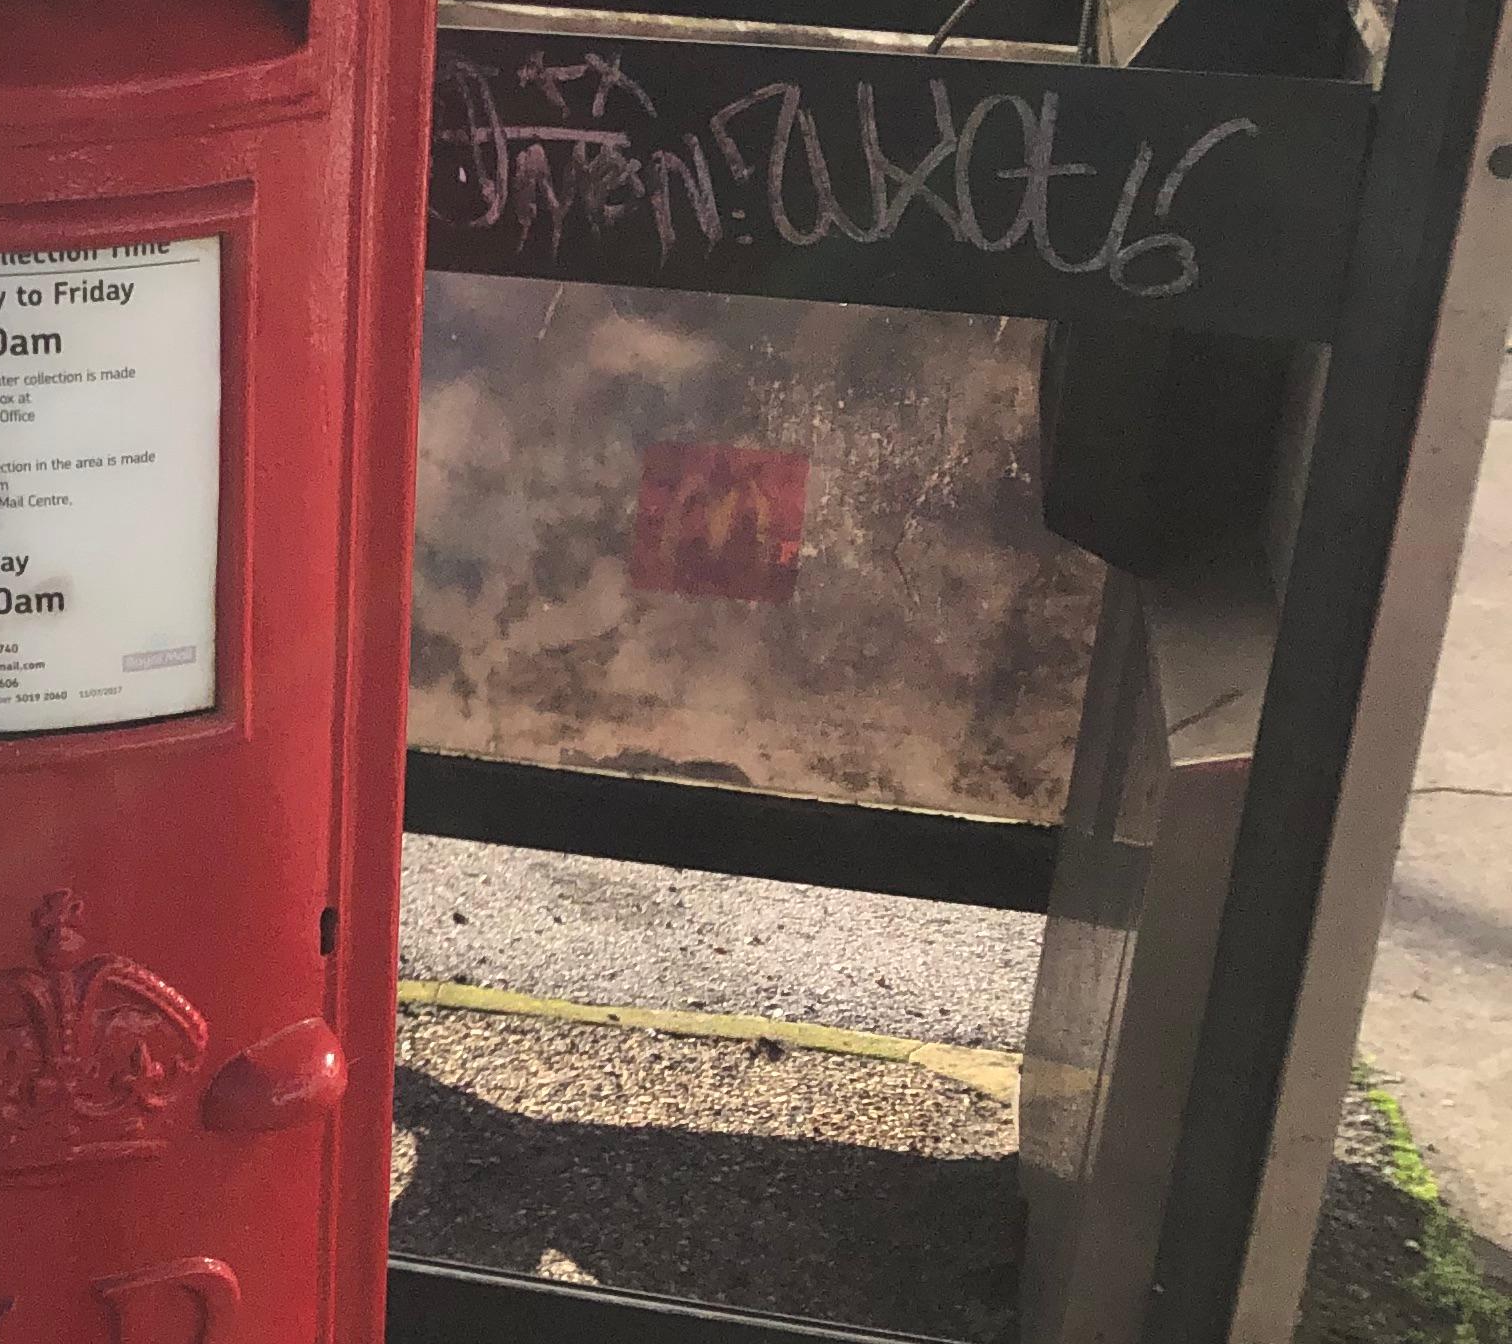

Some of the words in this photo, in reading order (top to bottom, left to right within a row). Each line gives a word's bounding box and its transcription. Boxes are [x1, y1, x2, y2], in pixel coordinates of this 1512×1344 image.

[17, 286, 42, 307] to
[54, 279, 135, 305] Friday
[23, 371, 83, 386] collection
[86, 369, 97, 382] is
[100, 366, 136, 380] made
[18, 393, 32, 404] at
[0, 409, 36, 423] Office
[35, 459, 47, 471] in
[51, 458, 72, 470] the
[75, 457, 103, 468] area
[107, 453, 117, 466] is
[120, 451, 156, 465] made
[28, 494, 73, 507] Centre,
